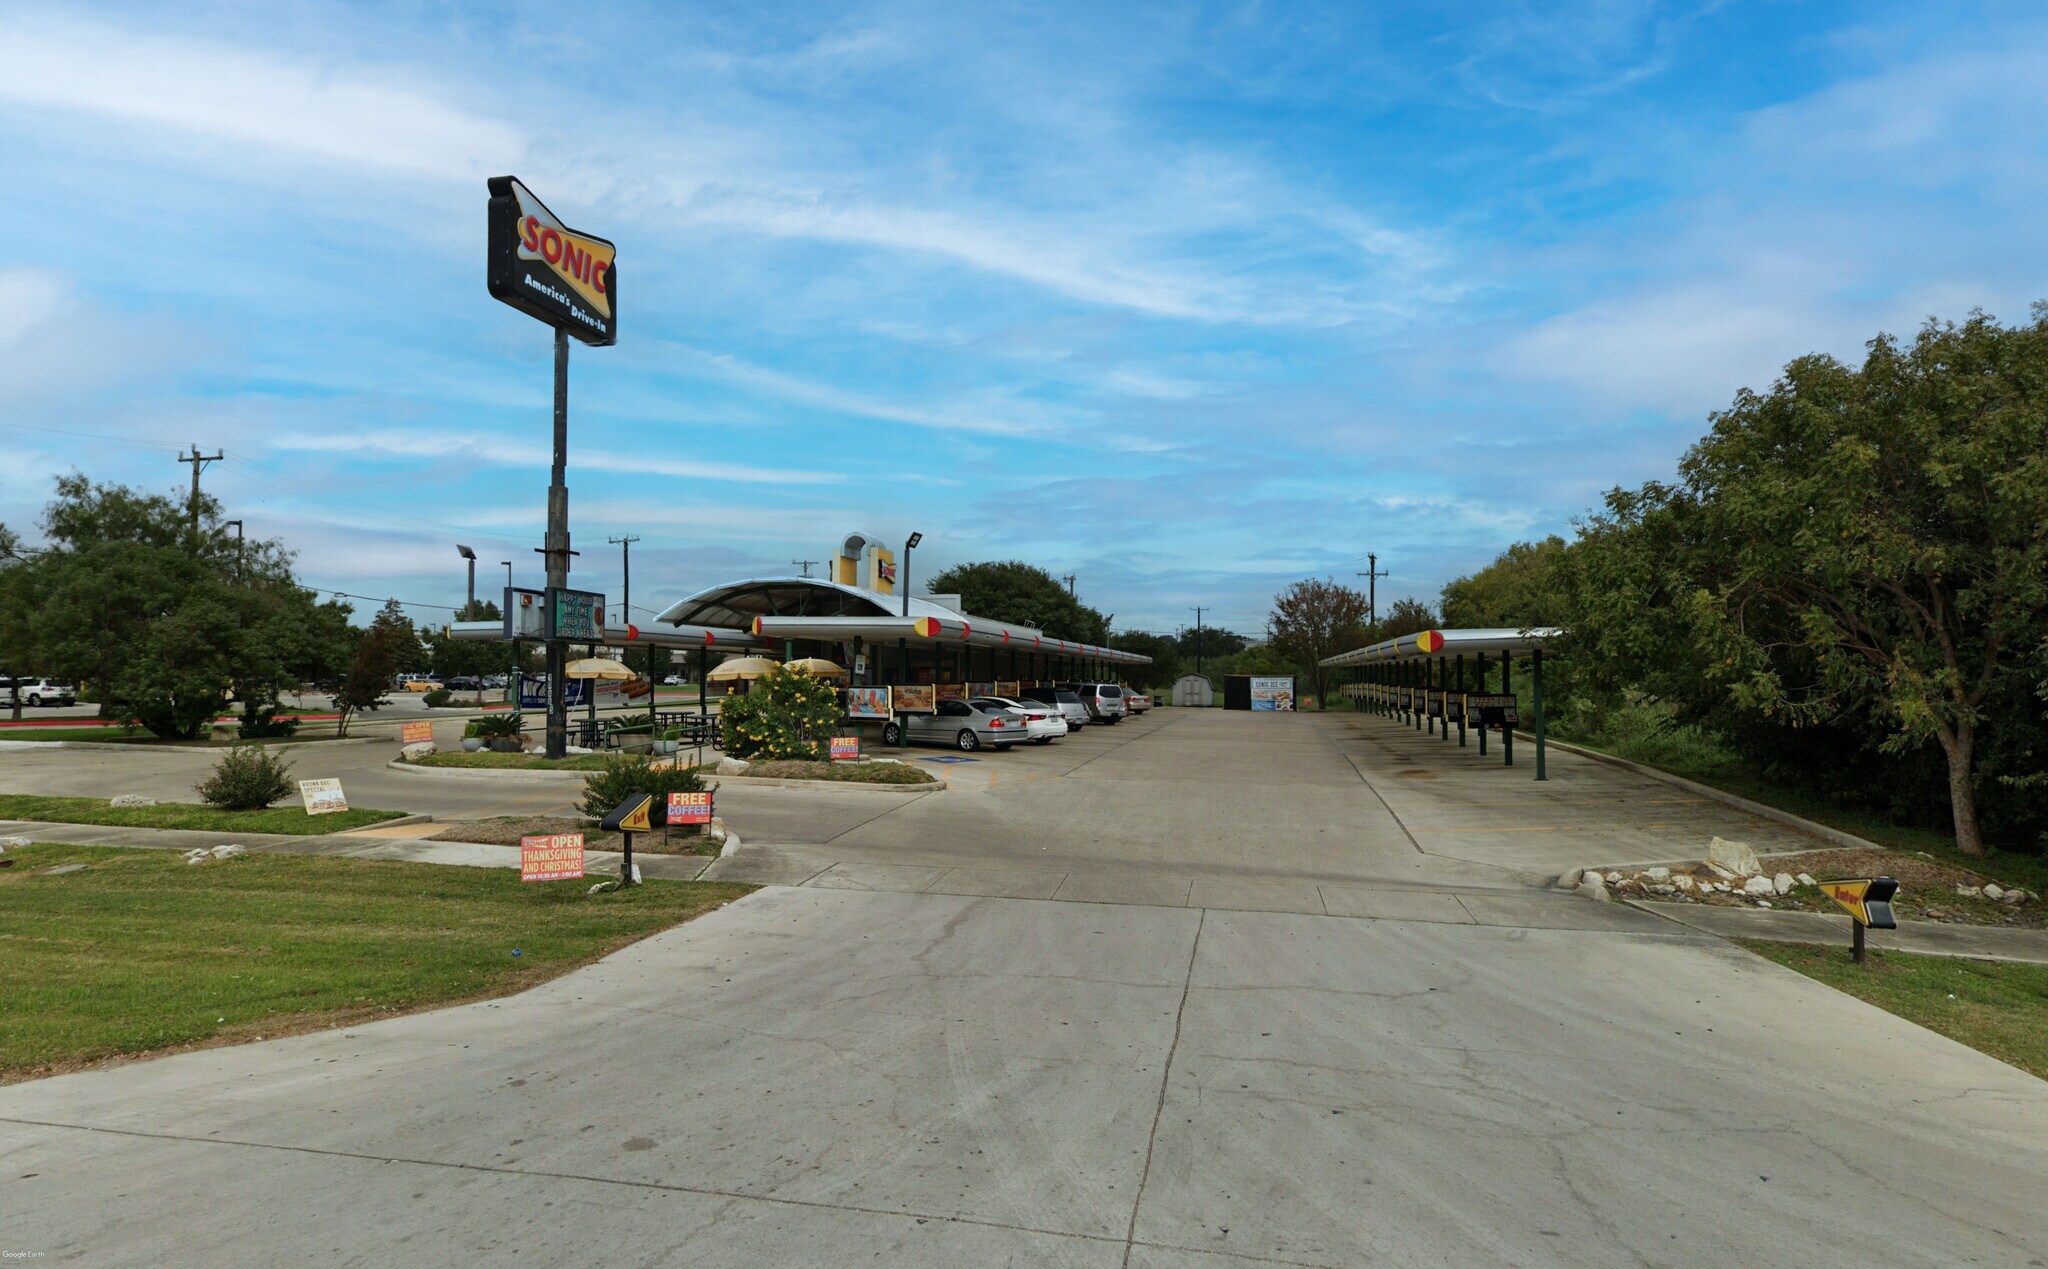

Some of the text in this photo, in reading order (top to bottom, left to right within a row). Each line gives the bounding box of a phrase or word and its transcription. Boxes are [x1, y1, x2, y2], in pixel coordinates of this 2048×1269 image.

[522, 214, 608, 294] SONIC
[524, 273, 607, 334] America's Drive-In
[833, 737, 856, 746] FREE
[673, 792, 706, 806] FREE
[668, 805, 710, 816] COFFEE!
[551, 834, 582, 849] OPEN
[523, 848, 582, 862] THANKSGIVING
[523, 859, 582, 873] AND CHRISTMAS!
[1834, 886, 1859, 906] Enter
